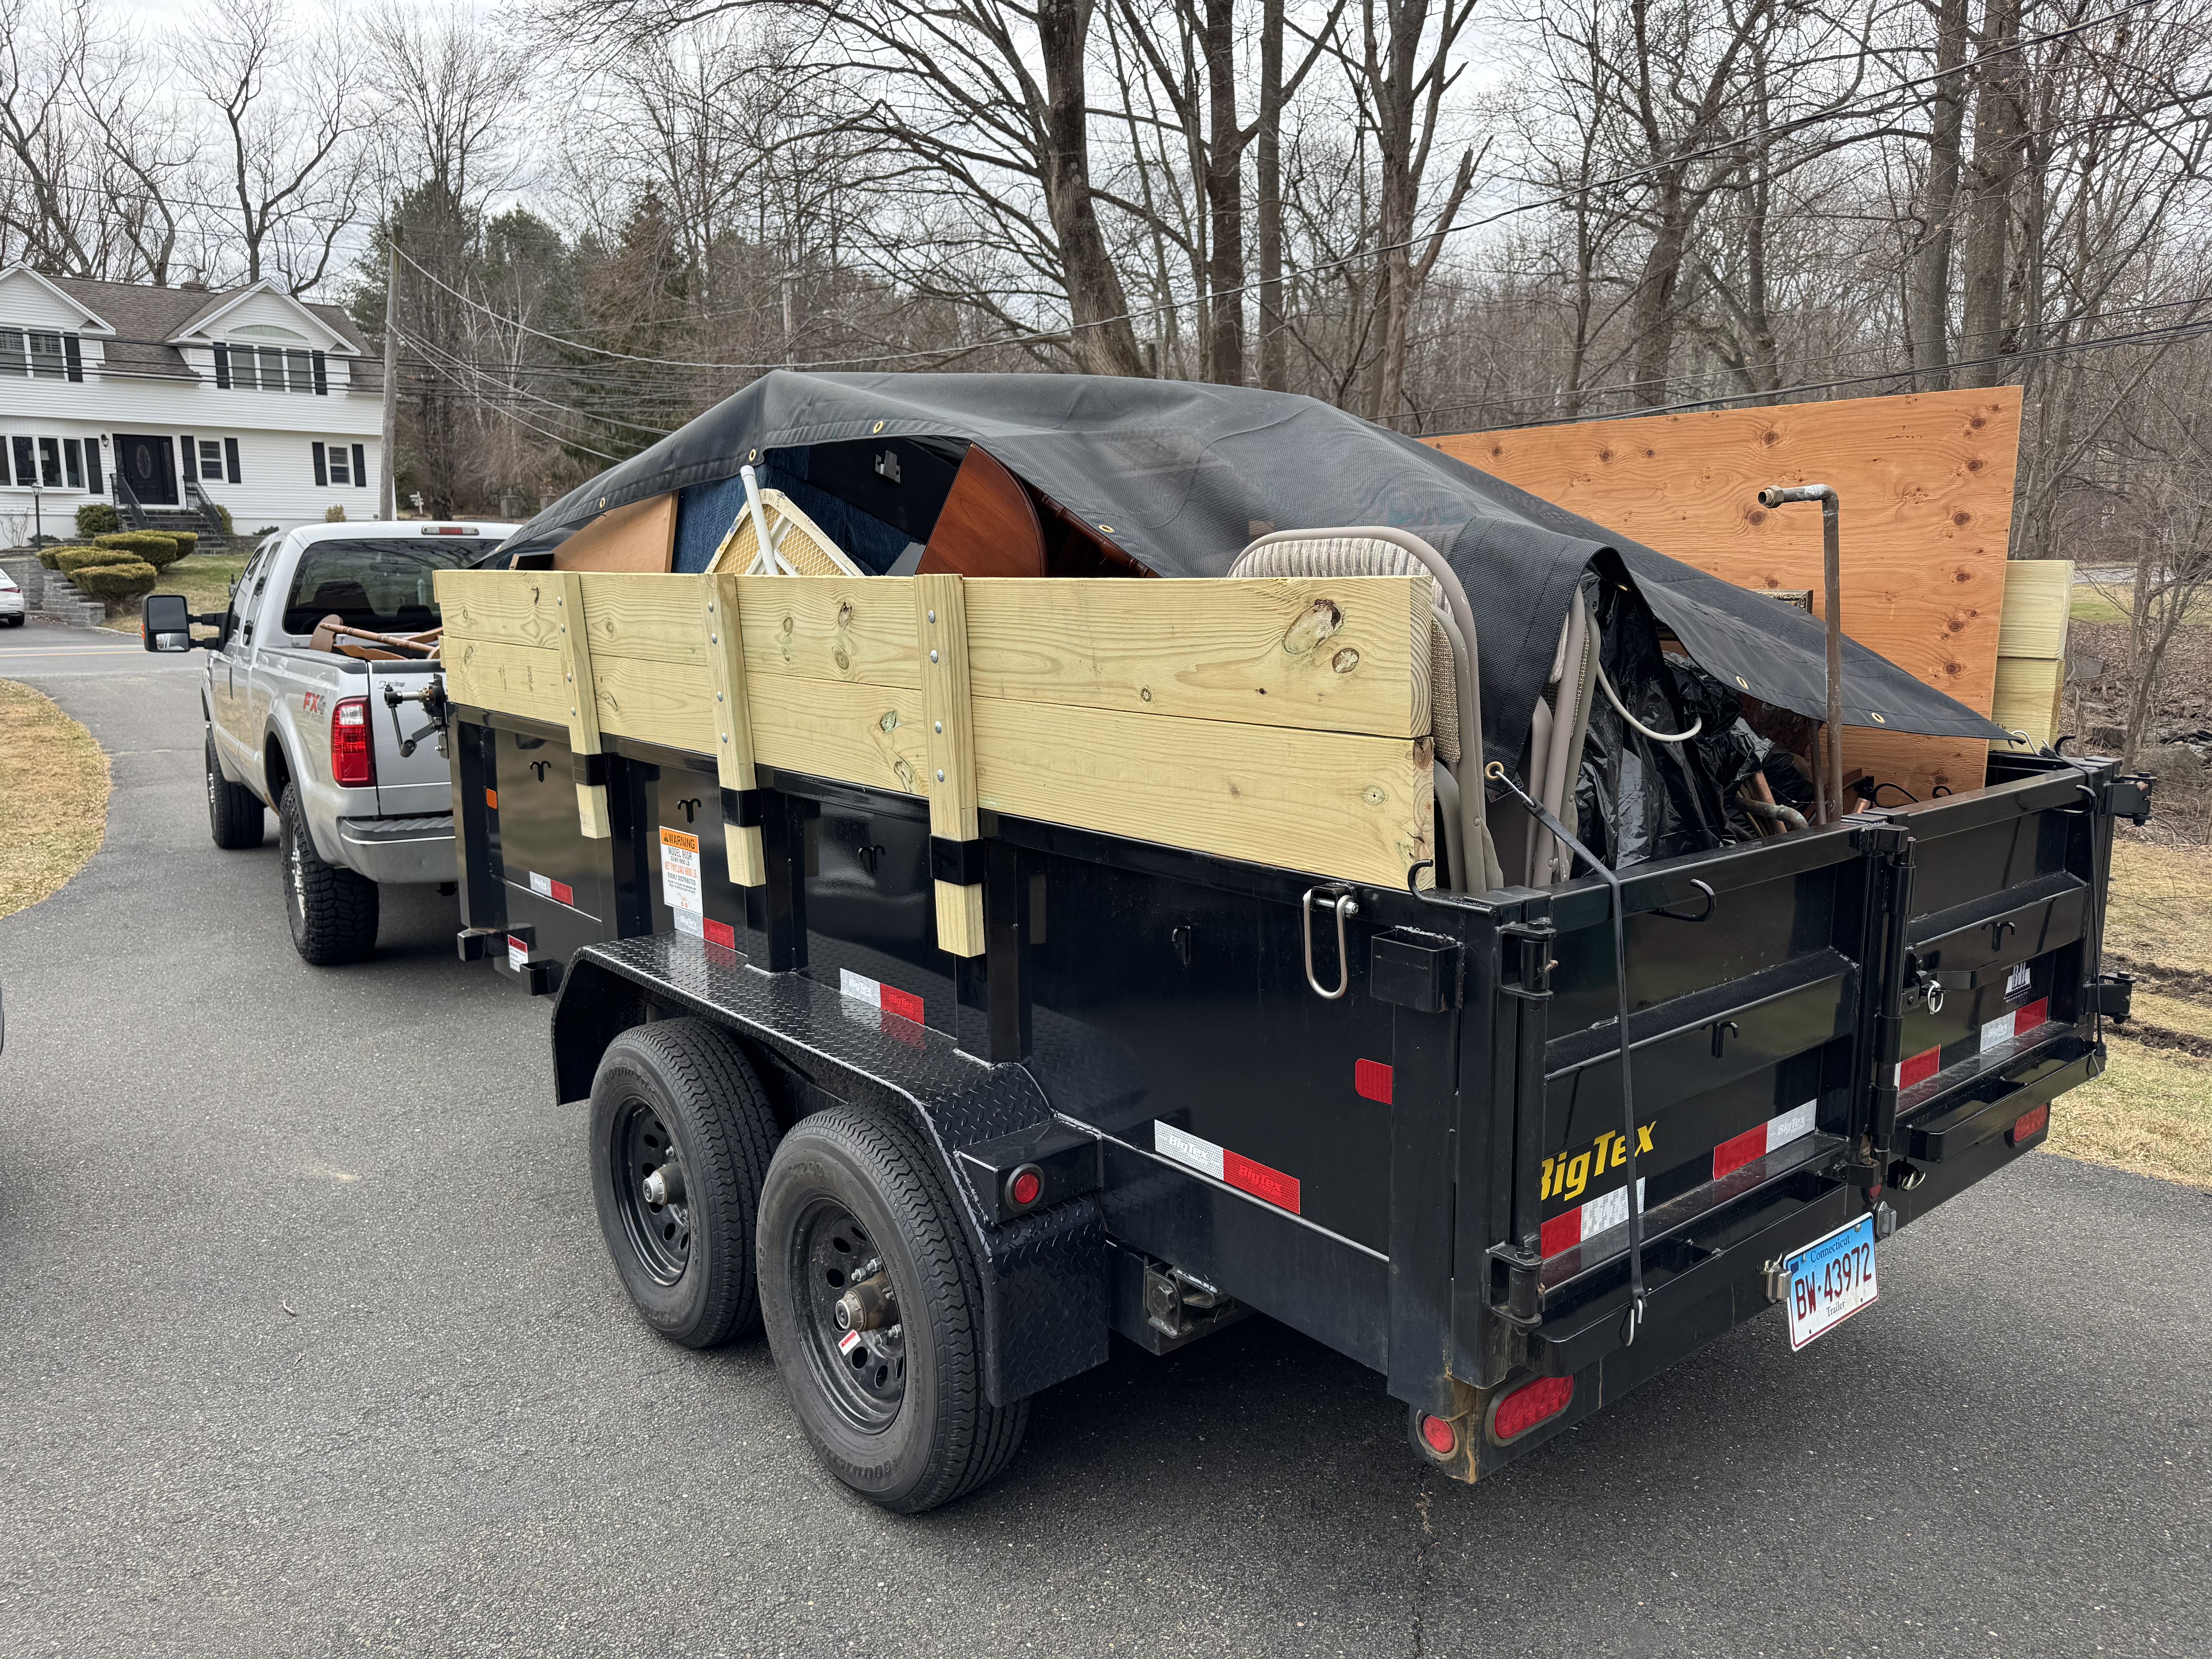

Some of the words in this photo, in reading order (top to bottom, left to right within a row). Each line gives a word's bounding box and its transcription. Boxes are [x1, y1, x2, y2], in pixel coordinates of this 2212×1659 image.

[303, 691, 326, 716] FX4
[668, 833, 695, 849] WARNING
[668, 846, 681, 858] MODEL
[668, 872, 677, 880] EVENLY
[678, 875, 696, 886] DISTRIBUTED
[849, 978, 871, 994] BigTex
[889, 993, 914, 1009] BigTex
[1778, 1115, 1806, 1136] BigTex
[1169, 1135, 1207, 1160] BigTex
[788, 1161, 824, 1179] ST200
[1541, 1120, 1657, 1202] BigTex
[1239, 1165, 1283, 1193] BigTex
[1810, 1235, 1851, 1263] Connecticut
[1826, 1300, 1845, 1317] Trailer
[814, 1434, 892, 1480] GOODRIDE
